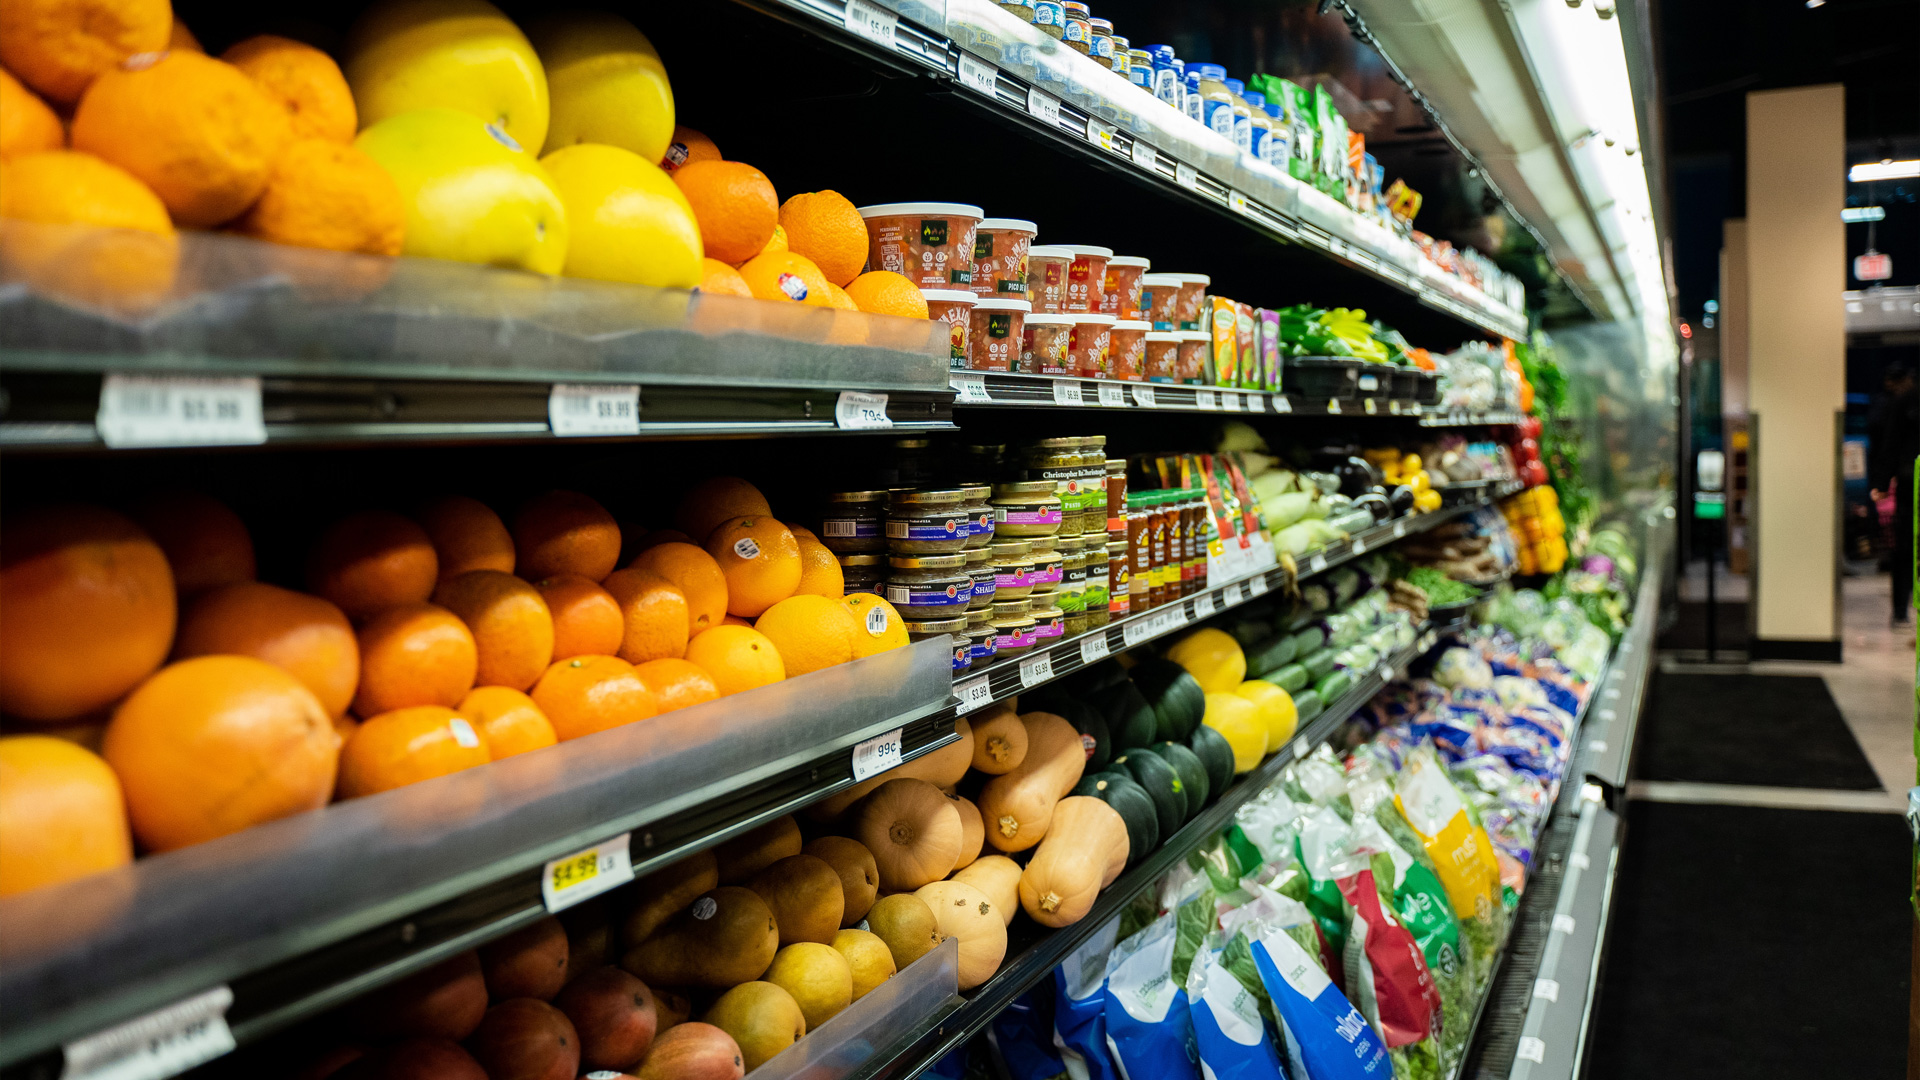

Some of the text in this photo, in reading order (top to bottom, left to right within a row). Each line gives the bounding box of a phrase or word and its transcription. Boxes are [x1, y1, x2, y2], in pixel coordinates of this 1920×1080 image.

[870, 19, 890, 39] $5.49
[977, 73, 993, 90] $4.49
[1007, 282, 1019, 291] PICO
[861, 409, 885, 422] 79¢
[1042, 470, 1077, 480] Christopher
[974, 584, 997, 594] SHALL
[1034, 662, 1048, 676] $3.99
[971, 685, 987, 701] $3.99
[877, 740, 897, 757] 99¢
[552, 850, 598, 888] $4.99
